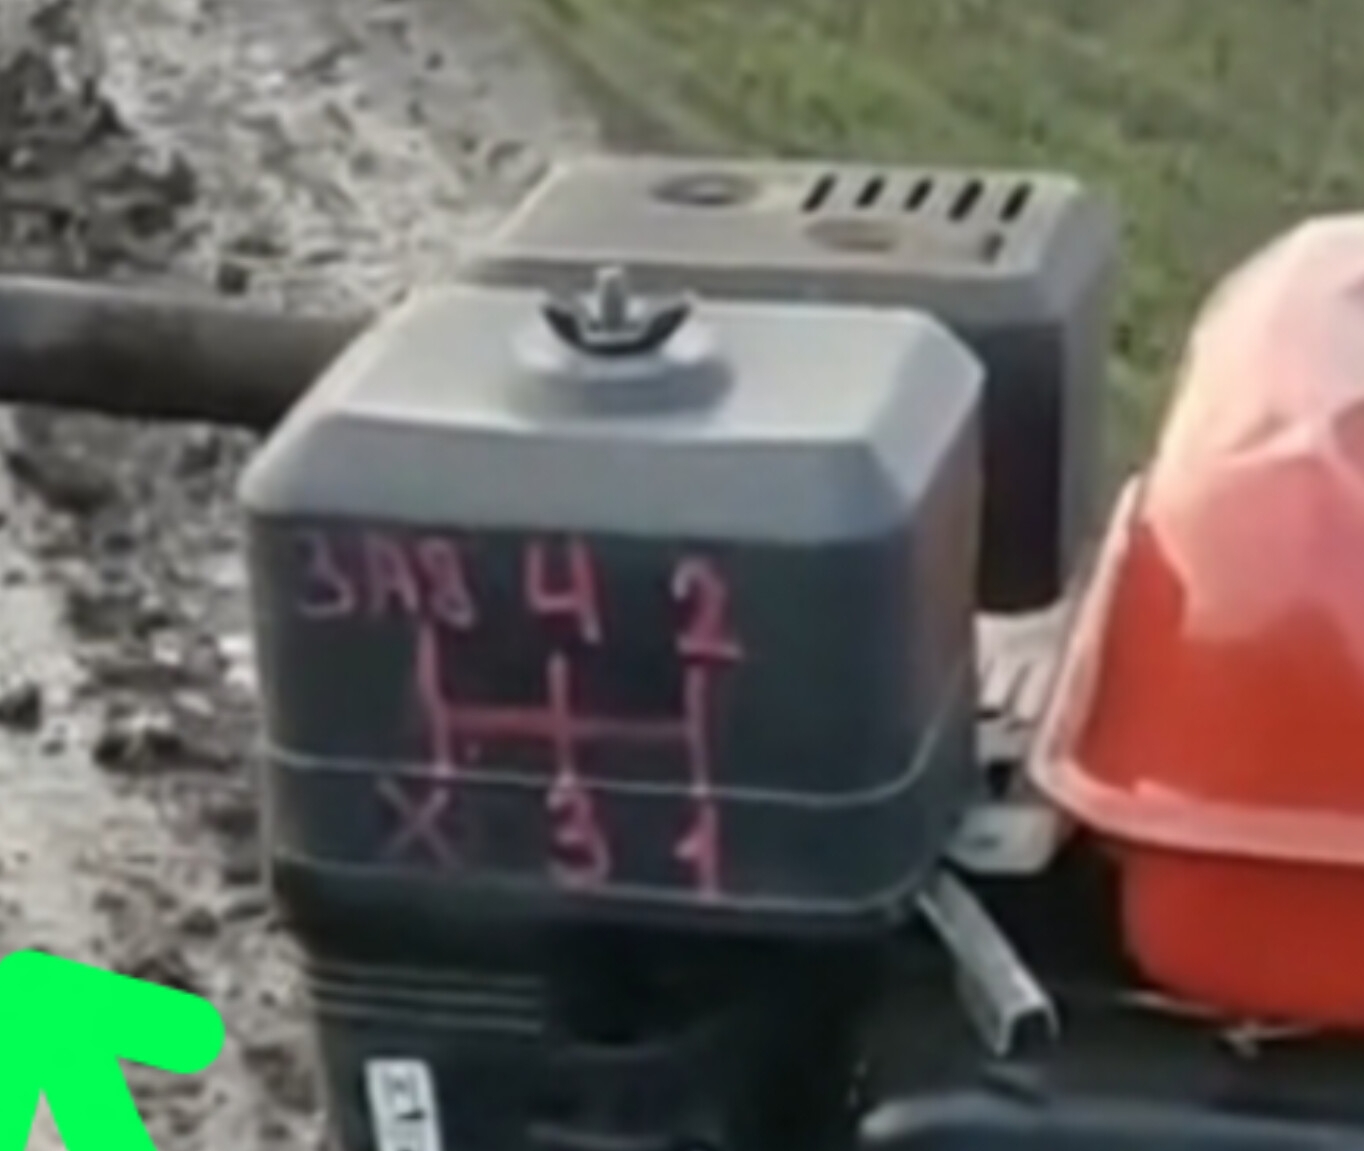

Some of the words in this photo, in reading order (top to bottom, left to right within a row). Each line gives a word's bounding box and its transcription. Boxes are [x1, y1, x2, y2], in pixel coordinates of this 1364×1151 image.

[524, 537, 602, 644] 4
[670, 556, 746, 660] 2
[546, 772, 612, 888] 3
[674, 802, 720, 900] 1
